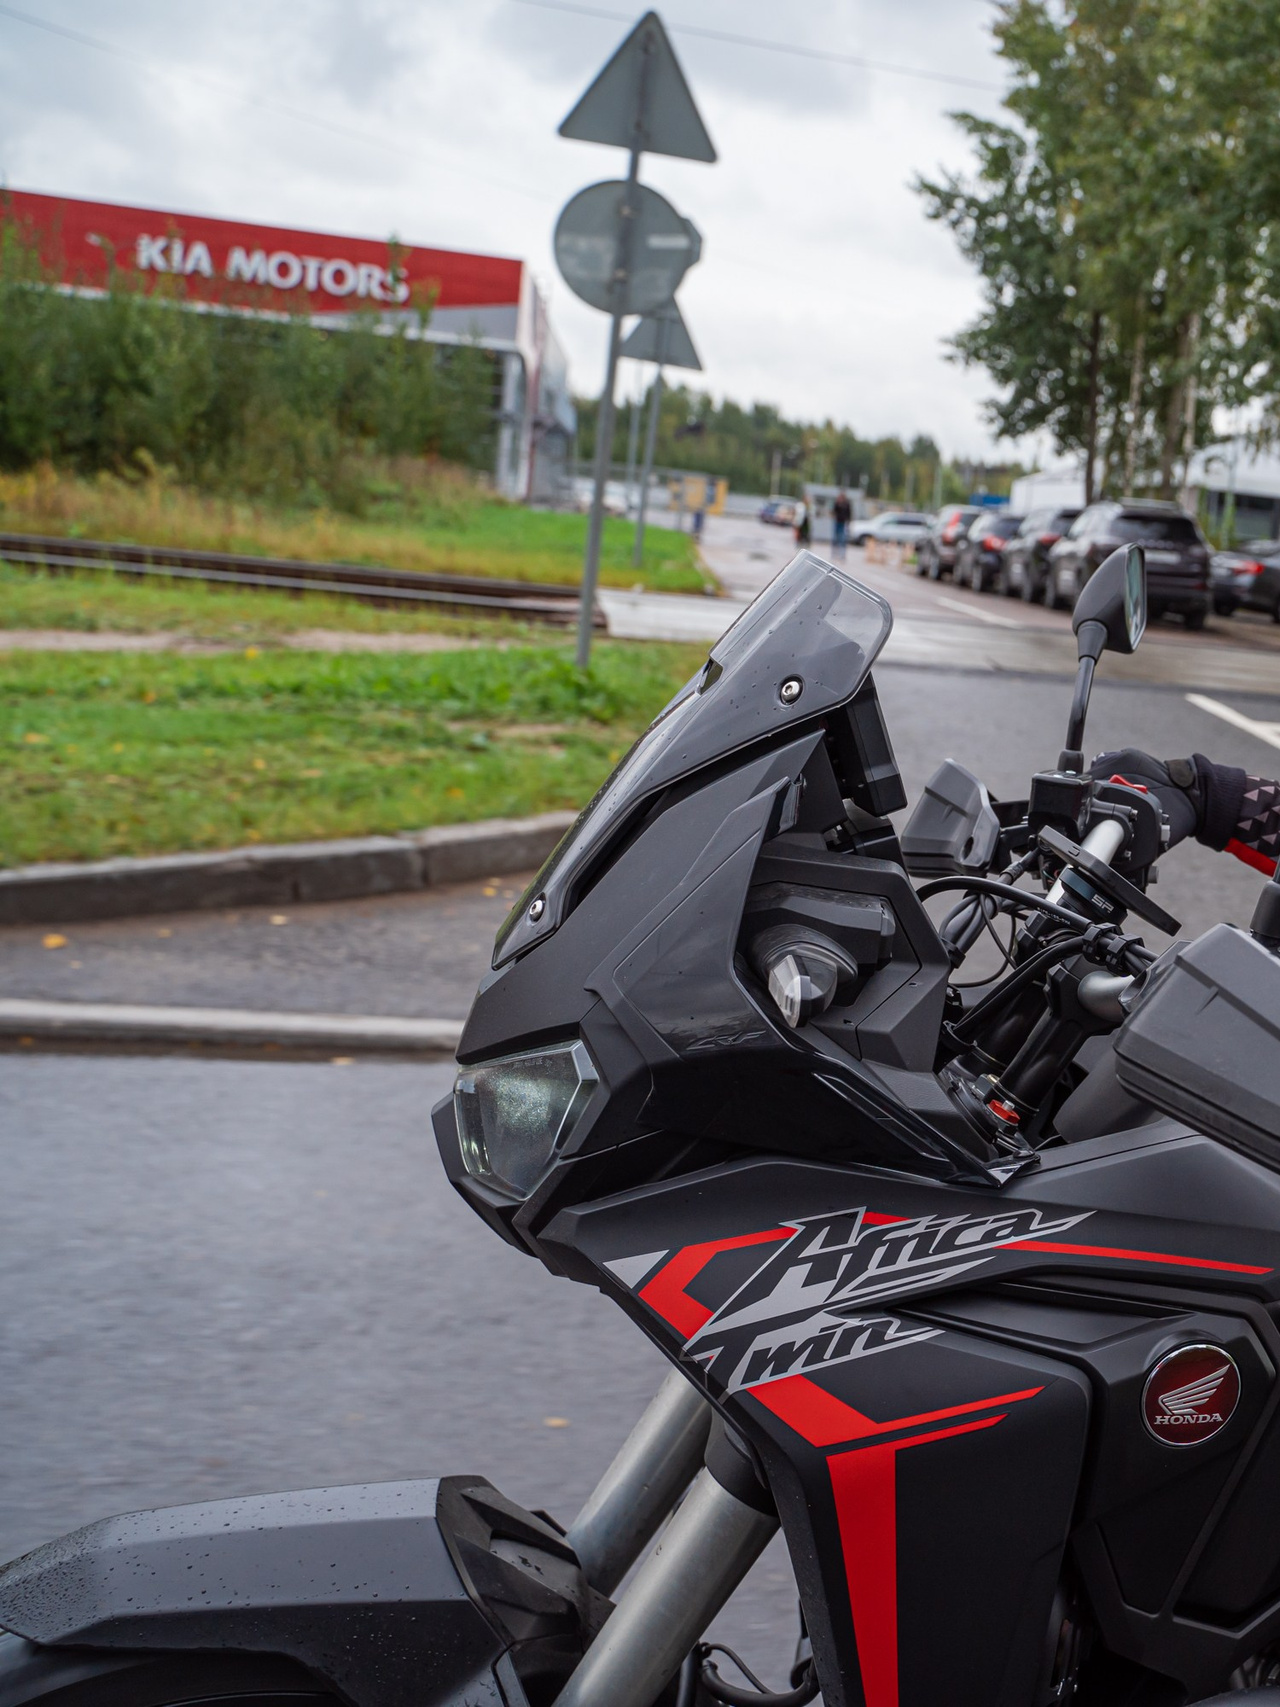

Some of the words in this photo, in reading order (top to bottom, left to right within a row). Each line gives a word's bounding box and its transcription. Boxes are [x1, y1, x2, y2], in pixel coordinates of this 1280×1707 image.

[135, 233, 214, 277] KIA
[225, 246, 410, 303] MOTORS
[694, 1207, 1097, 1336] Africa
[693, 1314, 946, 1398] Twin
[1153, 1412, 1224, 1426] HONDA
